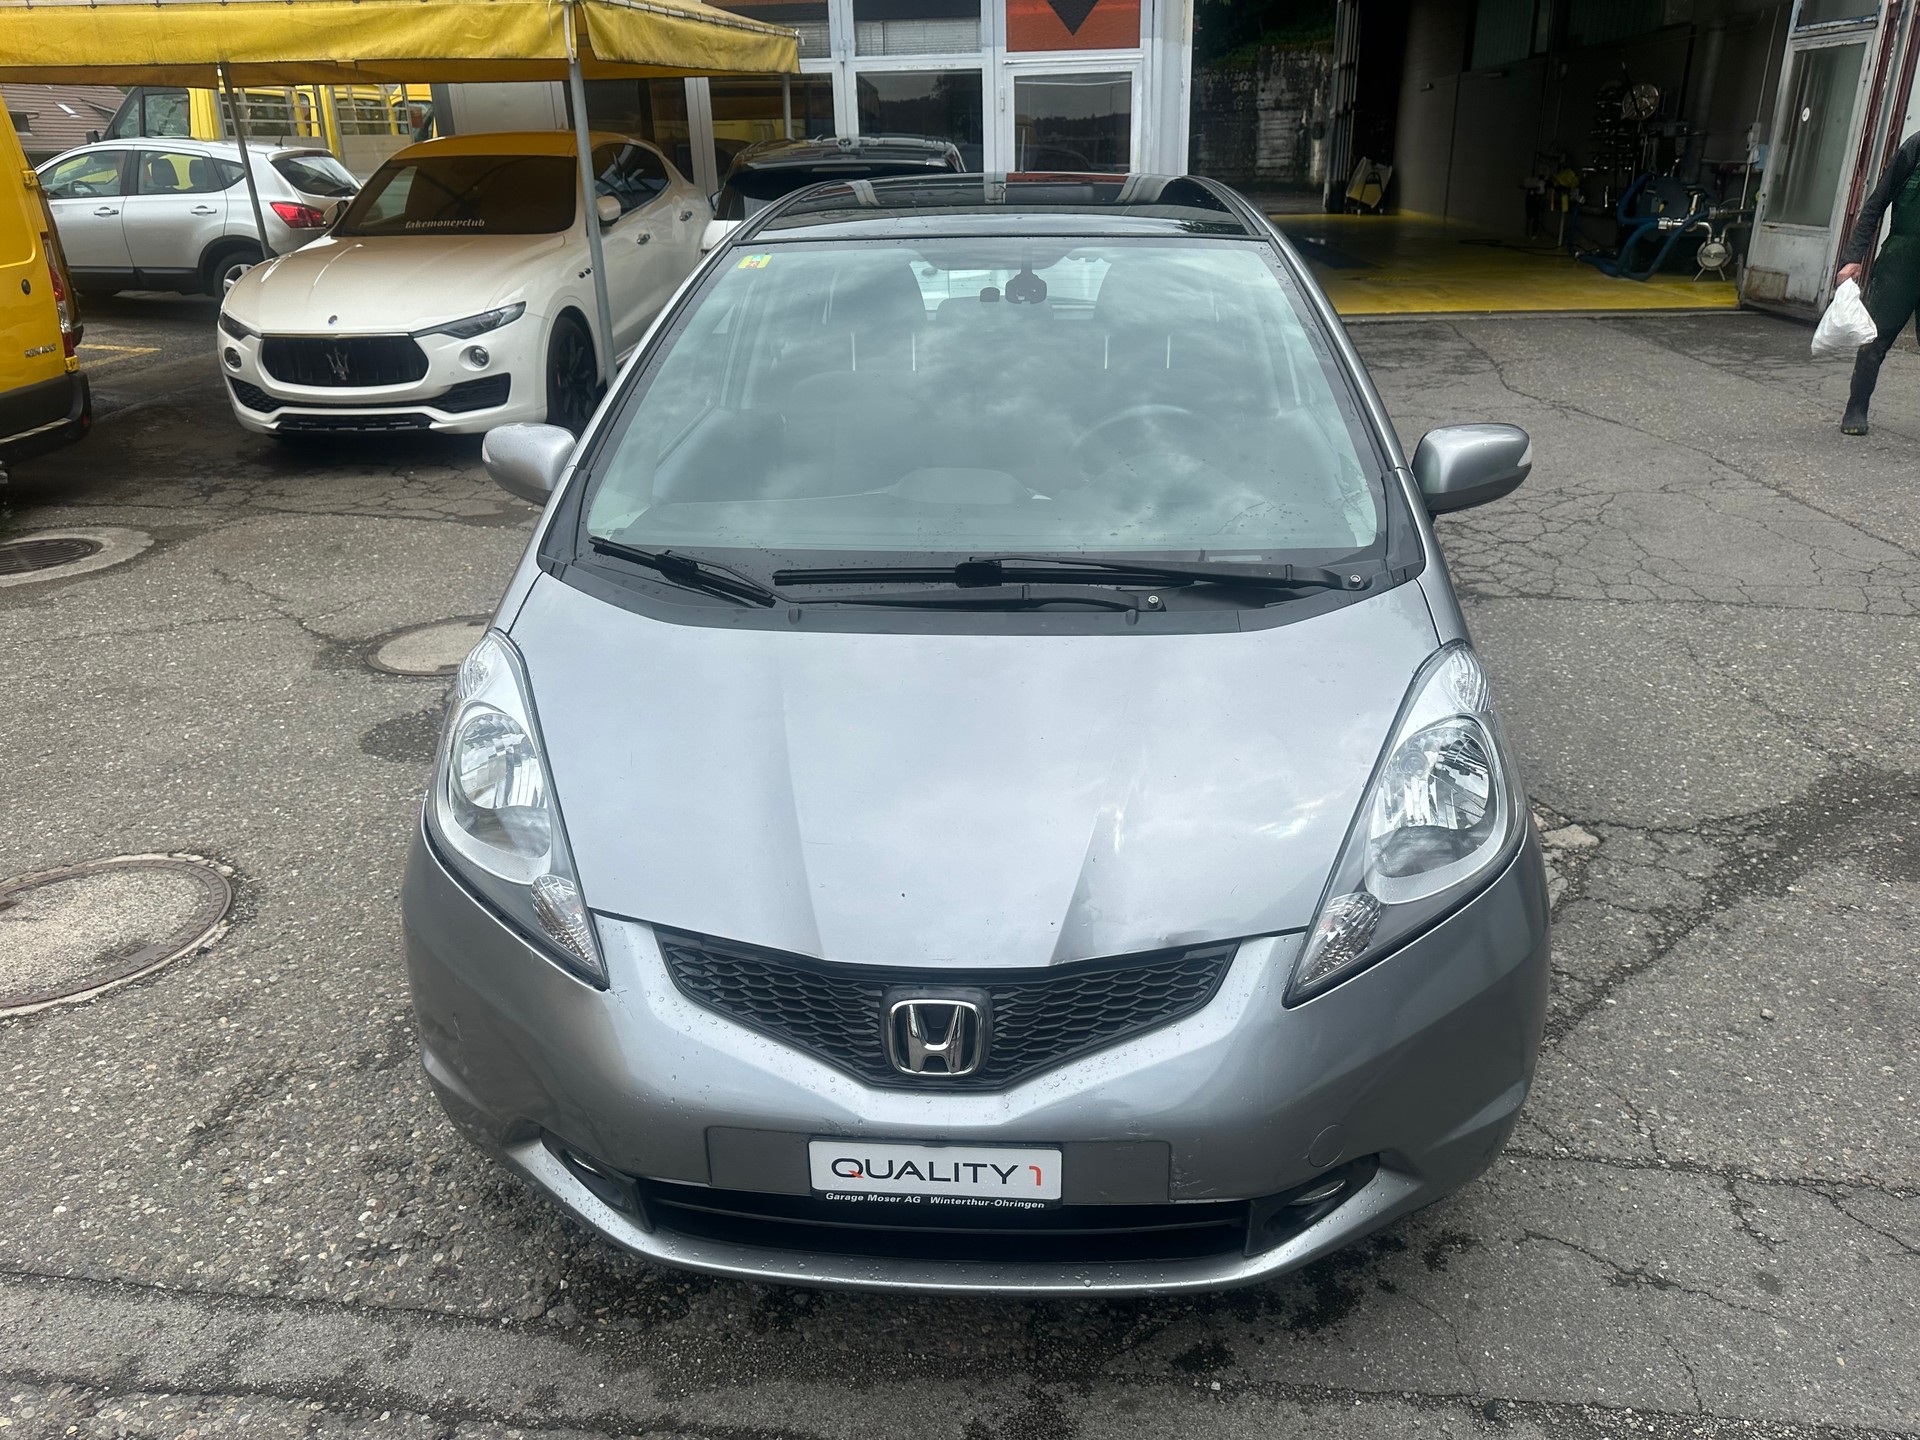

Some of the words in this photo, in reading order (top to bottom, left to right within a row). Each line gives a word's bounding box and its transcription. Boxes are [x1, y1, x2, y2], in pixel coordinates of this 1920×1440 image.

[831, 1157, 1019, 1185] QUALITY
[1028, 1165, 1042, 1187] 1
[825, 1192, 864, 1203] Garage
[867, 1194, 901, 1203] Moser
[904, 1195, 921, 1204] AG
[930, 1196, 1045, 1210] Winterthur-Ohringen
